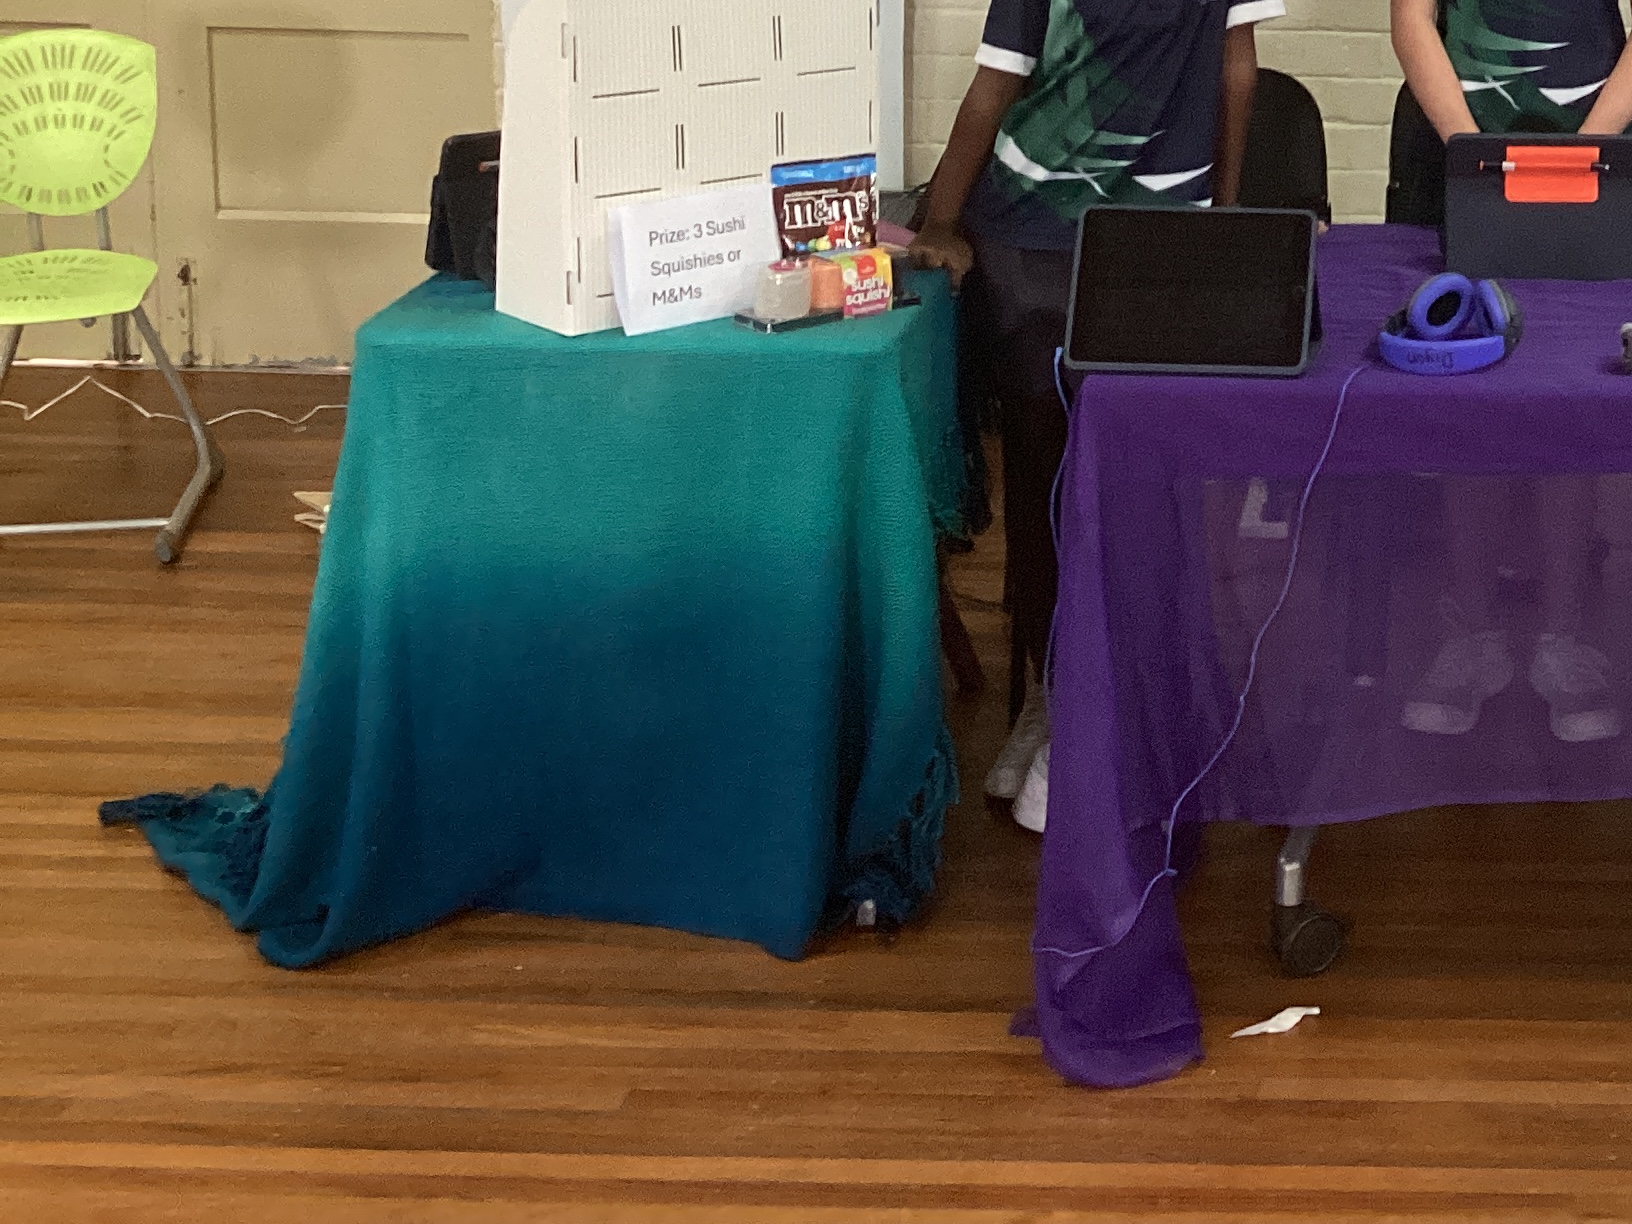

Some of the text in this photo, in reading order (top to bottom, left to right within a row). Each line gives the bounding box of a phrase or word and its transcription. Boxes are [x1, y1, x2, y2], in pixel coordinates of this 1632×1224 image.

[648, 215, 745, 247] Prize: 3 Sushi
[650, 249, 741, 277] Squishies or
[652, 284, 702, 306] M&Ms
